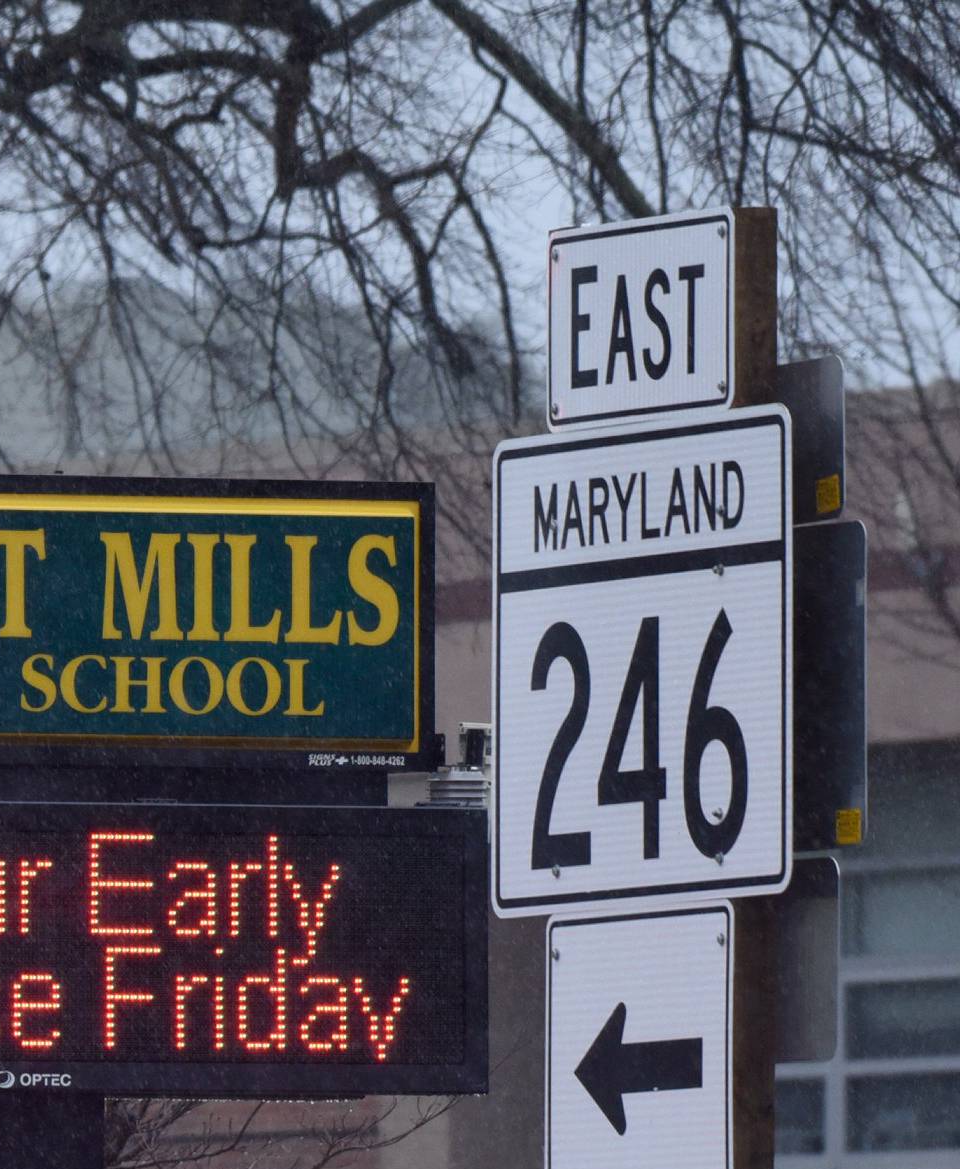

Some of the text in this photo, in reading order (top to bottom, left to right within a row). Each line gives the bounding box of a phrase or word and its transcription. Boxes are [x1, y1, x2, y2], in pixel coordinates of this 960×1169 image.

[571, 264, 705, 389] EAST
[534, 460, 744, 553] MARYLAND
[101, 531, 400, 646] MILLS
[21, 653, 325, 717] SCHOOL
[531, 608, 748, 870] 246
[89, 832, 340, 967] Early
[104, 944, 409, 1062] Friday
[20, 1073, 72, 1087] OPTEC
